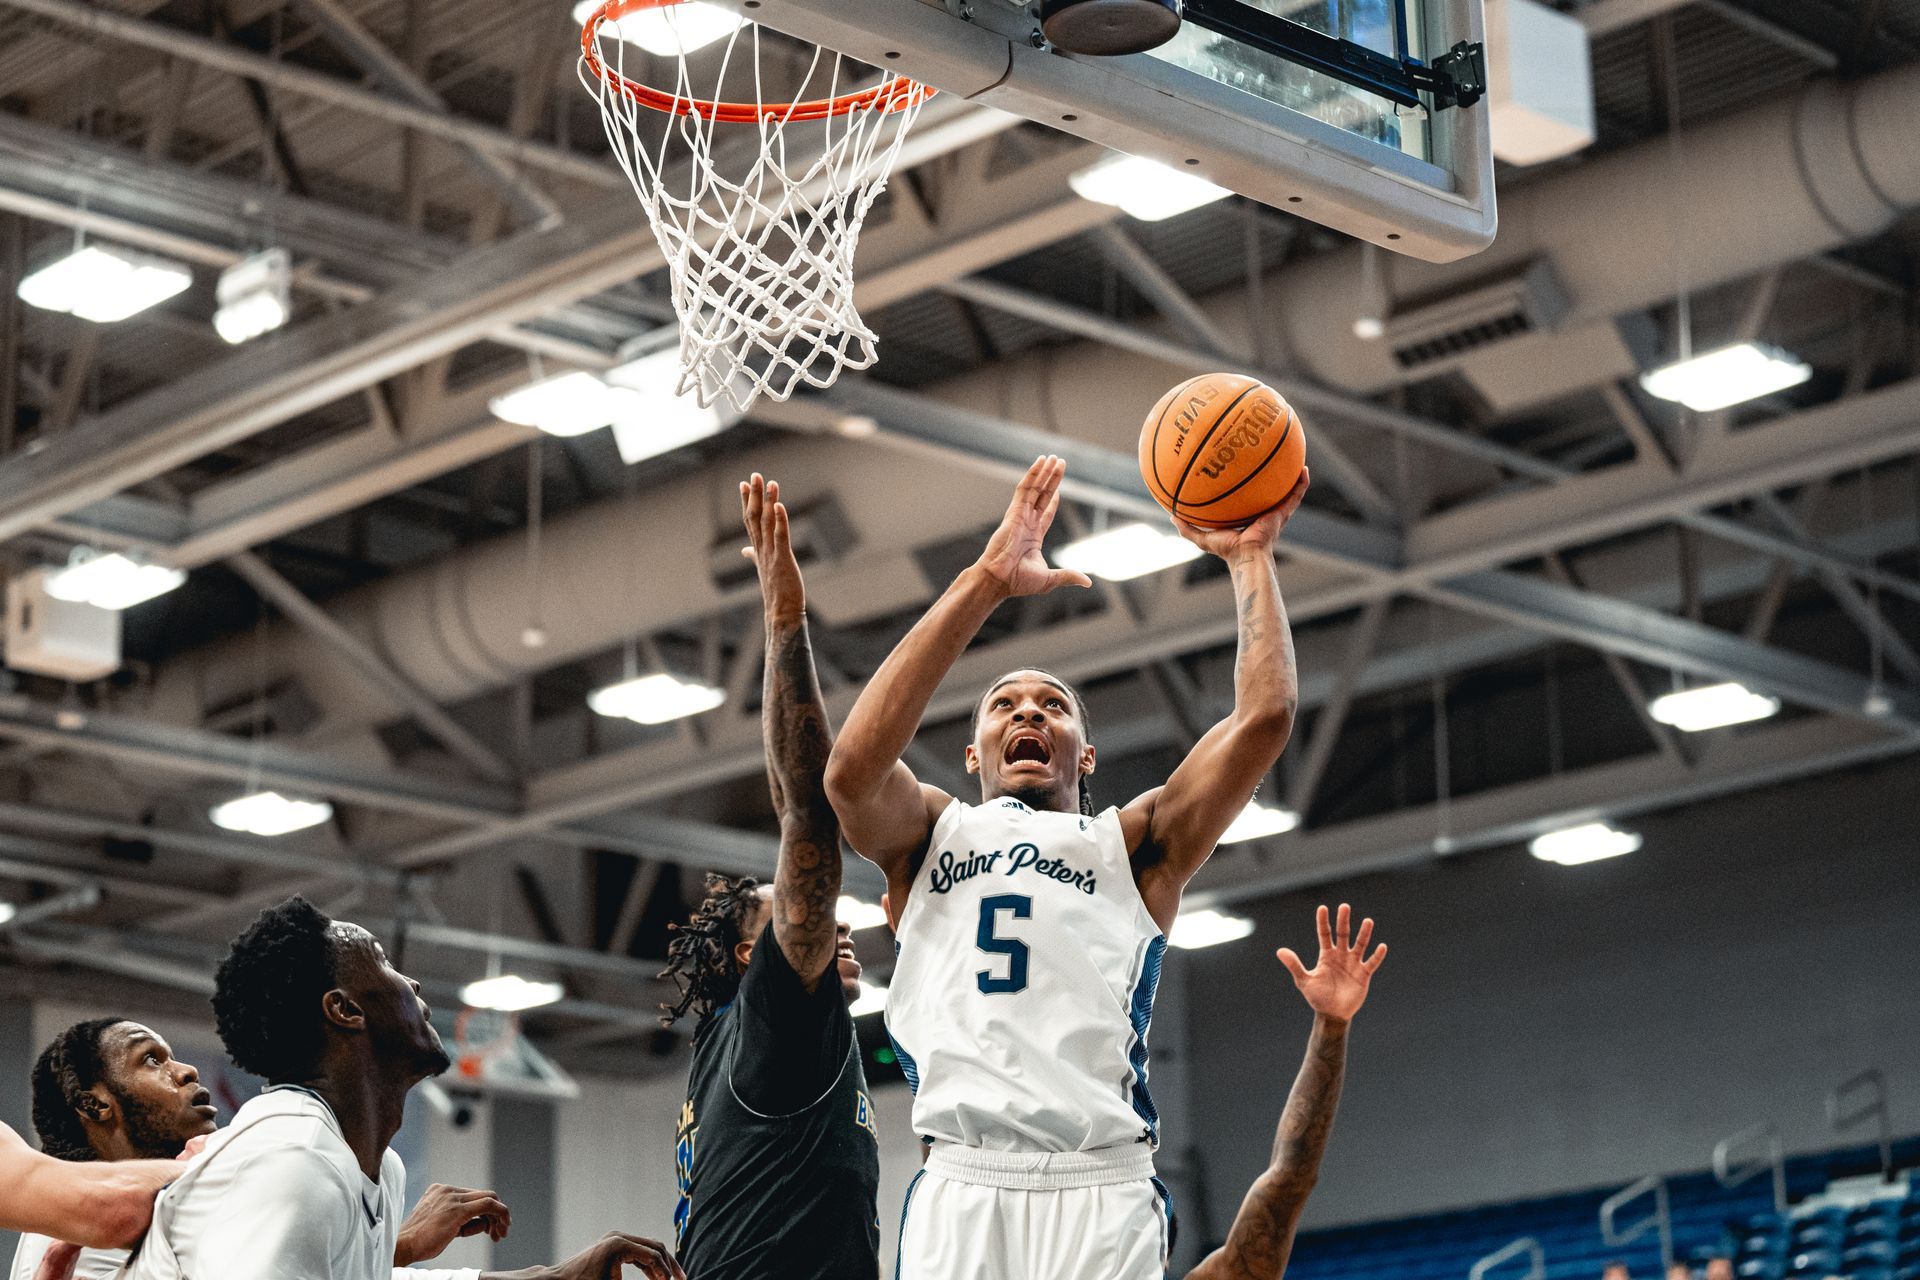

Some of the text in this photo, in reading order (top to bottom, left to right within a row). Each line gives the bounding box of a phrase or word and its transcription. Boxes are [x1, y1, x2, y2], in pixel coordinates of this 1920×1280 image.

[1174, 385, 1219, 456] EVO NXT
[1202, 397, 1282, 479] Wilson
[929, 842, 1096, 895] Saint Peter's
[975, 892, 1033, 996] 5
